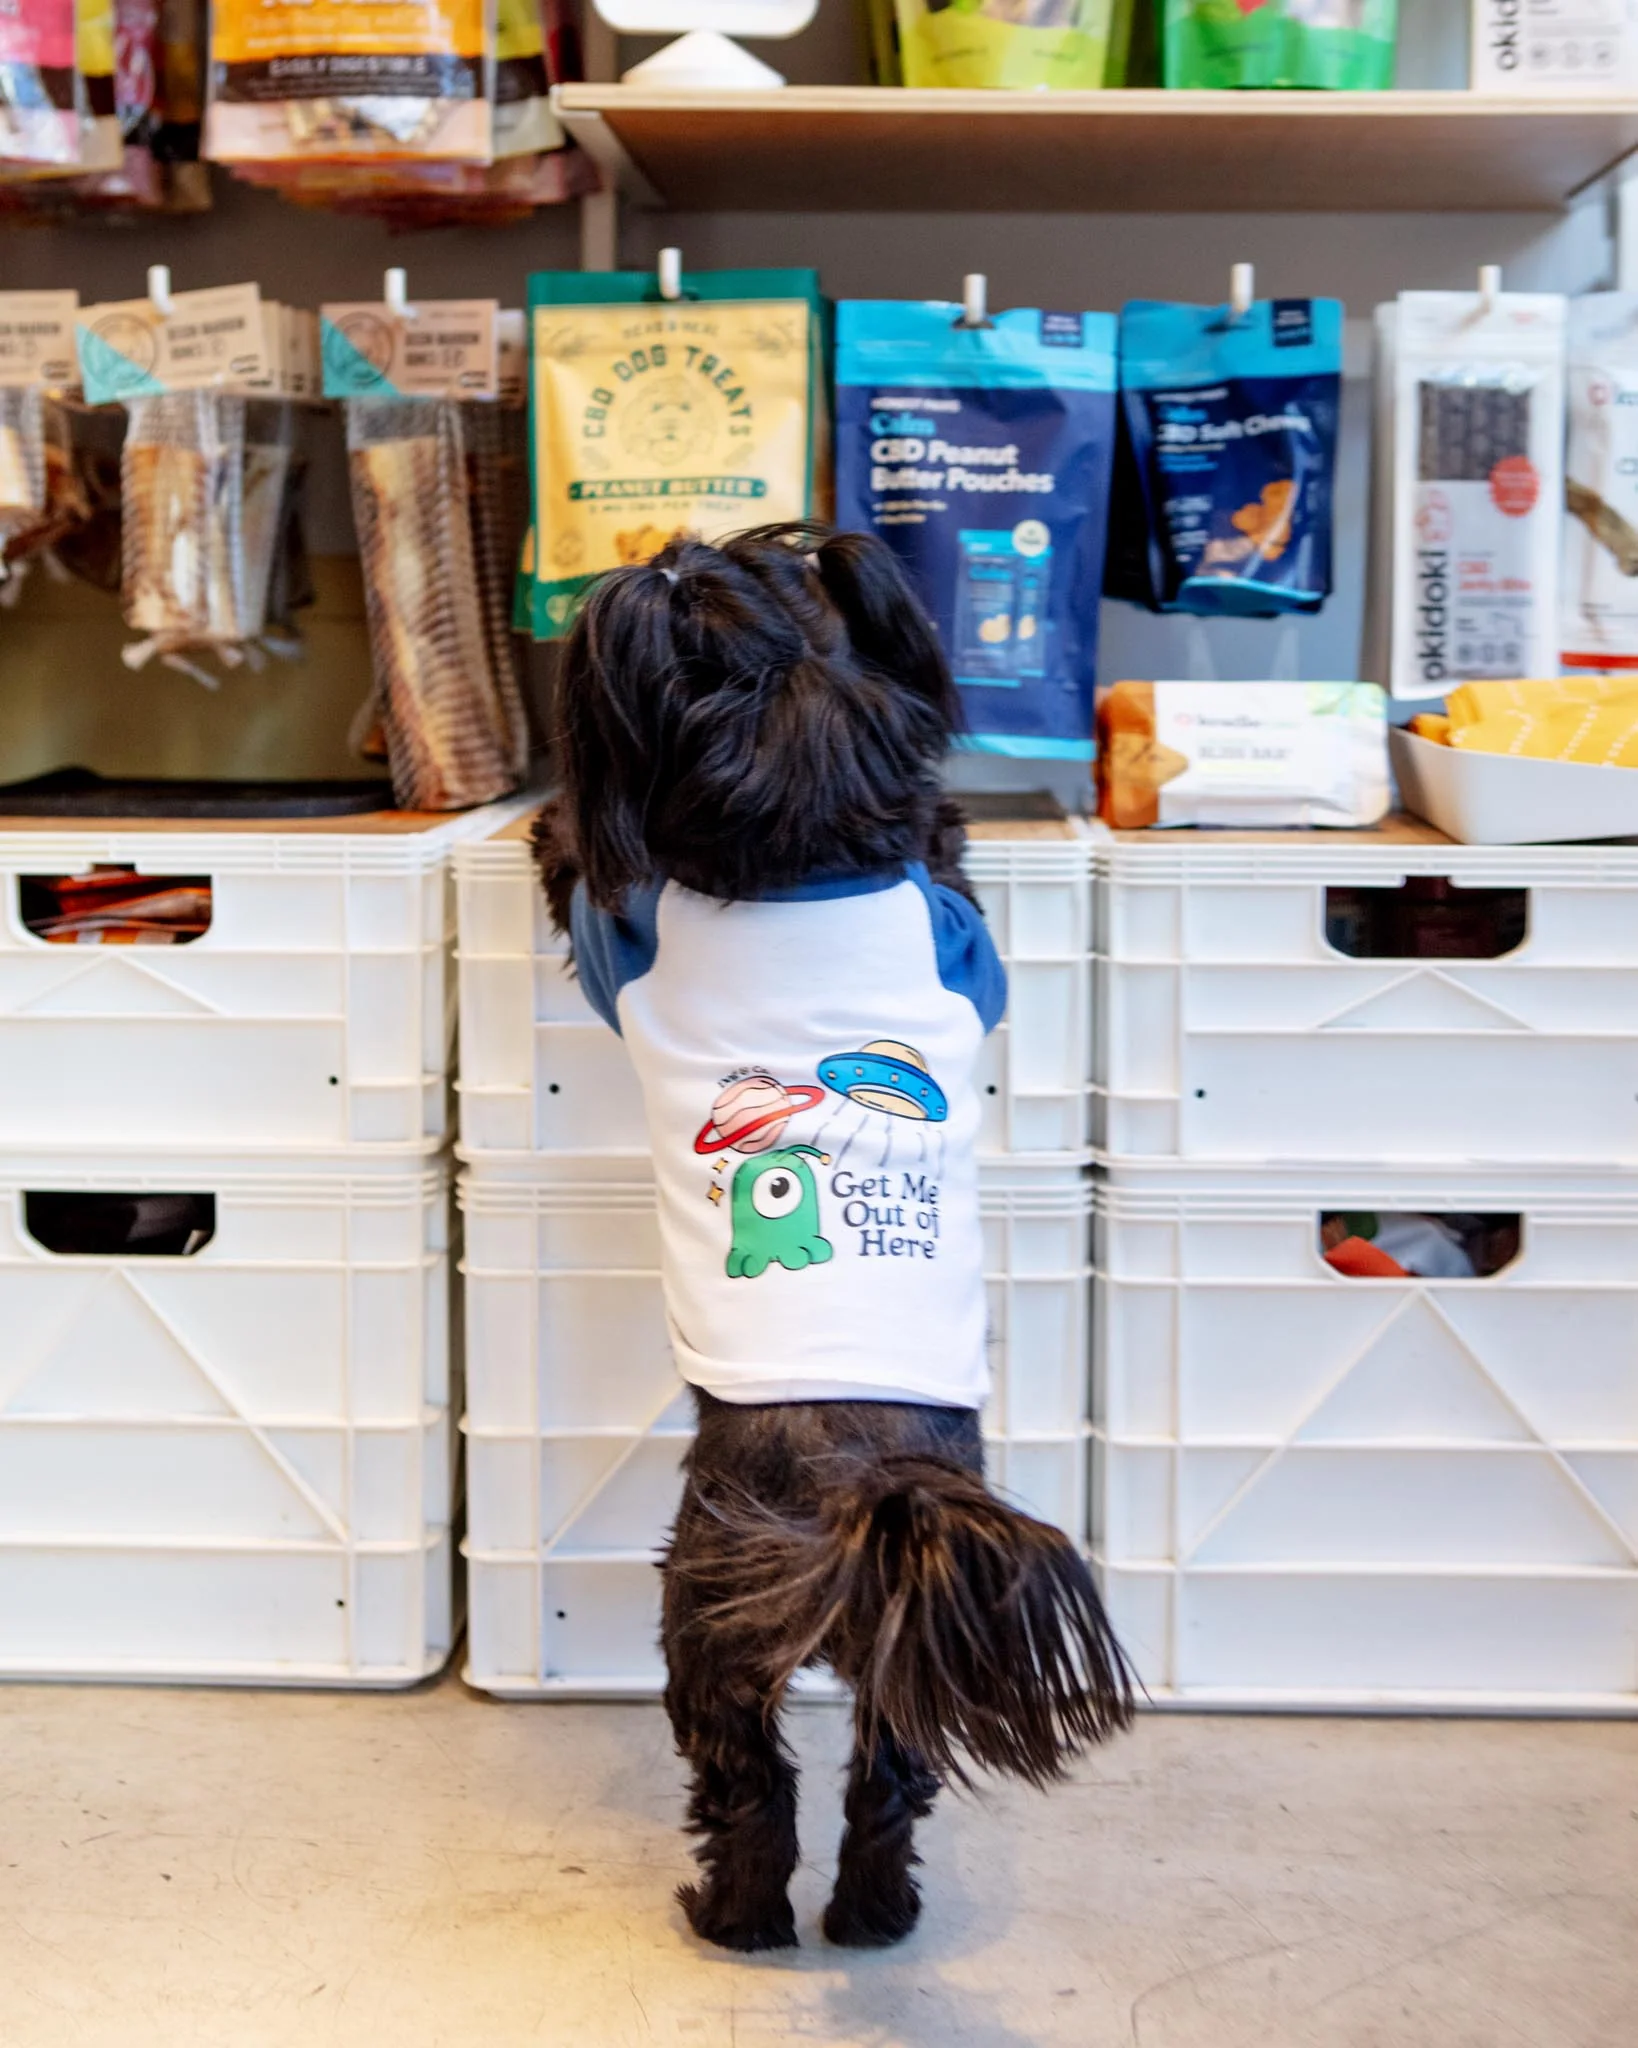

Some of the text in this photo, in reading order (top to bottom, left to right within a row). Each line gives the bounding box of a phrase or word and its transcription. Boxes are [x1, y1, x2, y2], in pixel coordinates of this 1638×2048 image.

[583, 344, 752, 438] CBD DOG TREATS
[870, 438, 1019, 466] CBD Peanut
[581, 480, 754, 498] PEANUT BUTTER
[870, 466, 1055, 493] Butter Pouches
[1416, 549, 1448, 682] okidoki
[831, 1171, 939, 1205] Get Me
[843, 1200, 940, 1238] Out of
[858, 1229, 936, 1259] Here
